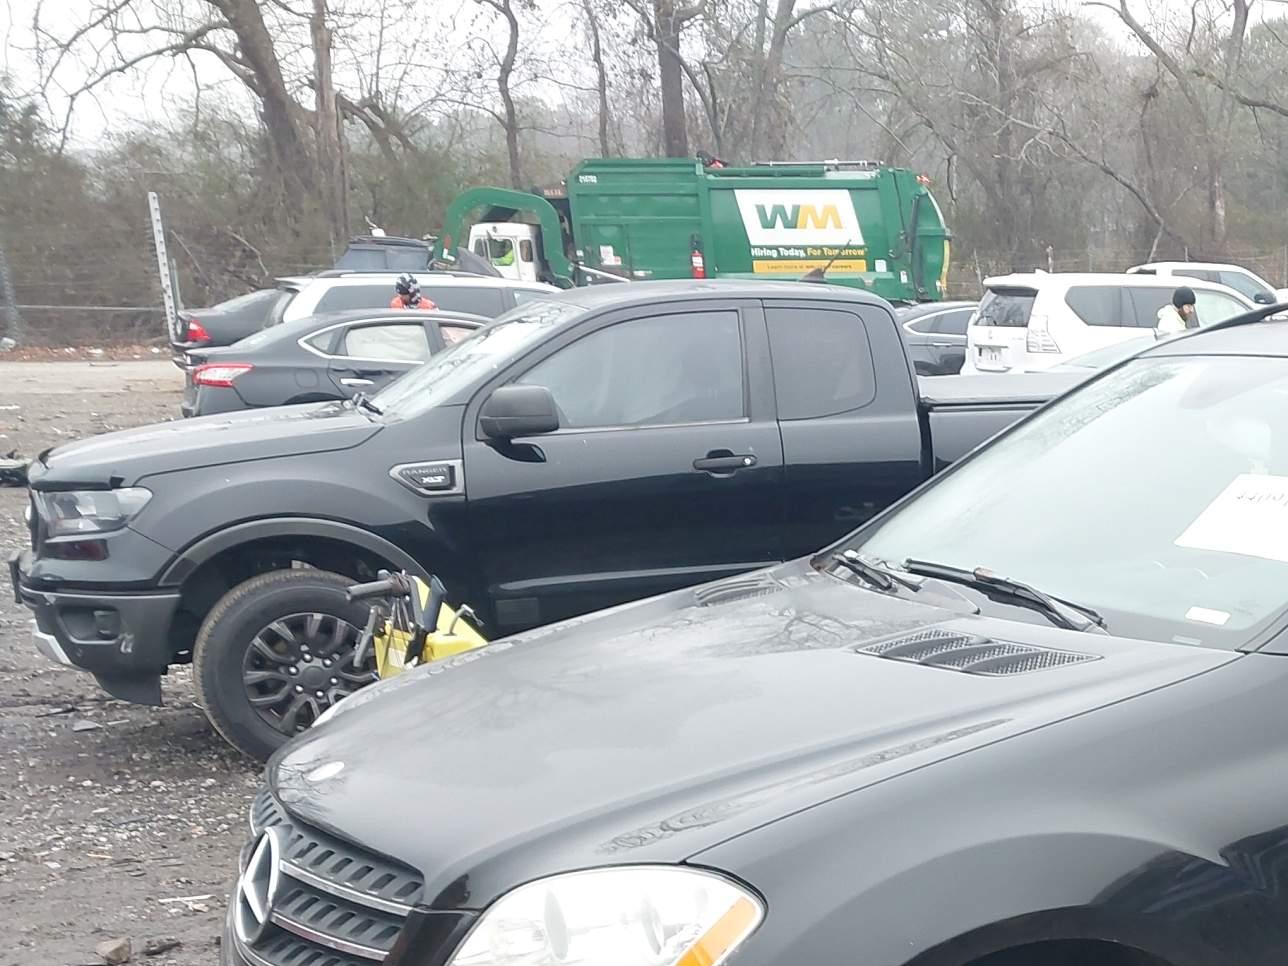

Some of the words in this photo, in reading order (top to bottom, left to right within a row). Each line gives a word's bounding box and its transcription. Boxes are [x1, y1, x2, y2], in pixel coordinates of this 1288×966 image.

[755, 204, 843, 229] WM
[751, 247, 778, 258] Hiring
[806, 247, 821, 256] For
